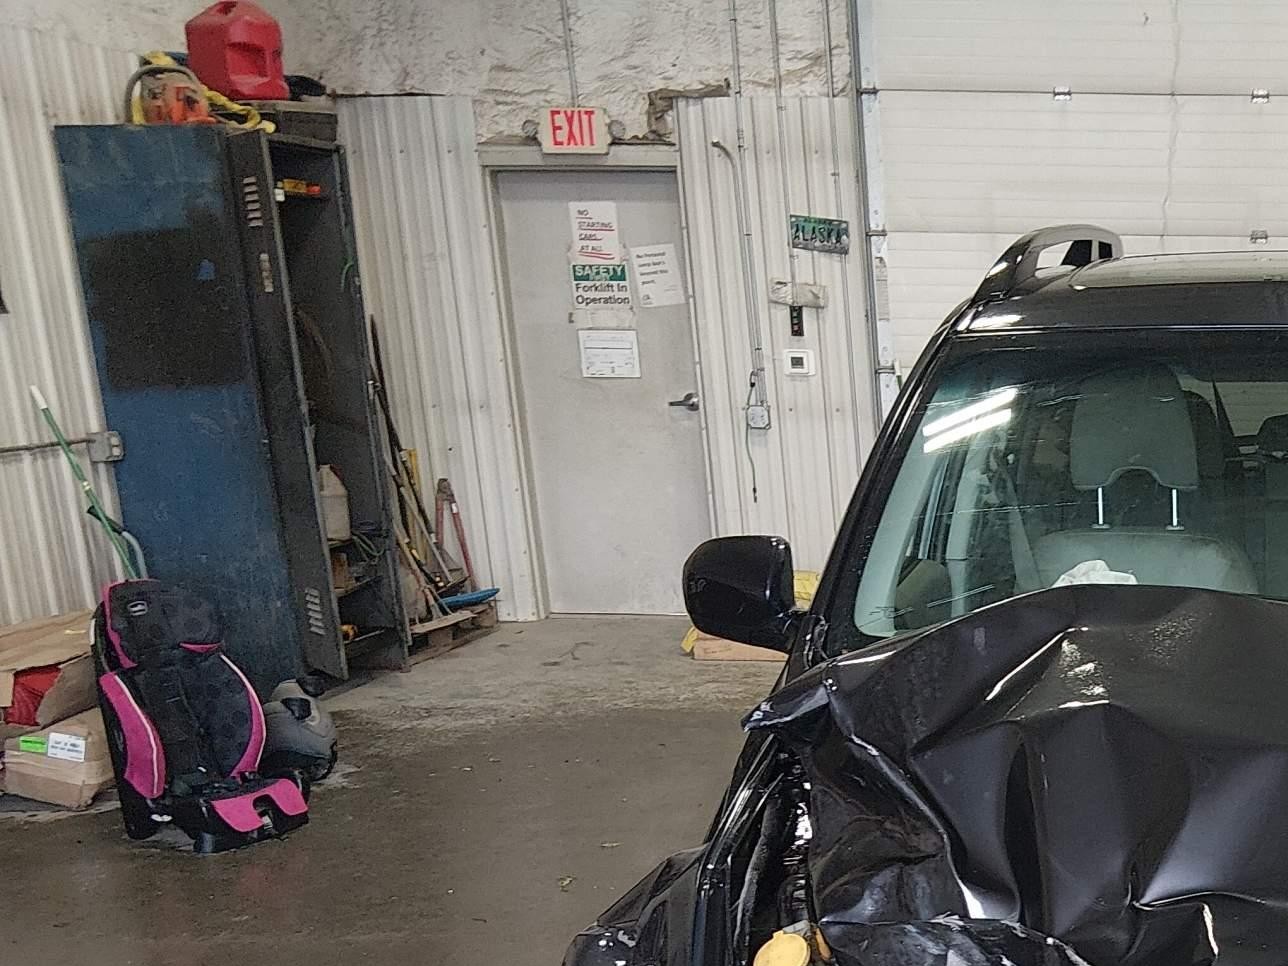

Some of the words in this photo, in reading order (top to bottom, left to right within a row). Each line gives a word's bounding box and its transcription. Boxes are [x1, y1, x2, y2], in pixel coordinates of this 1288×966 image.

[550, 109, 595, 146] EXIT
[793, 223, 842, 245] ALASKA
[575, 265, 623, 276] SAFETY
[576, 283, 614, 292] Forklift
[617, 283, 628, 292] In
[576, 295, 630, 306] Operation
